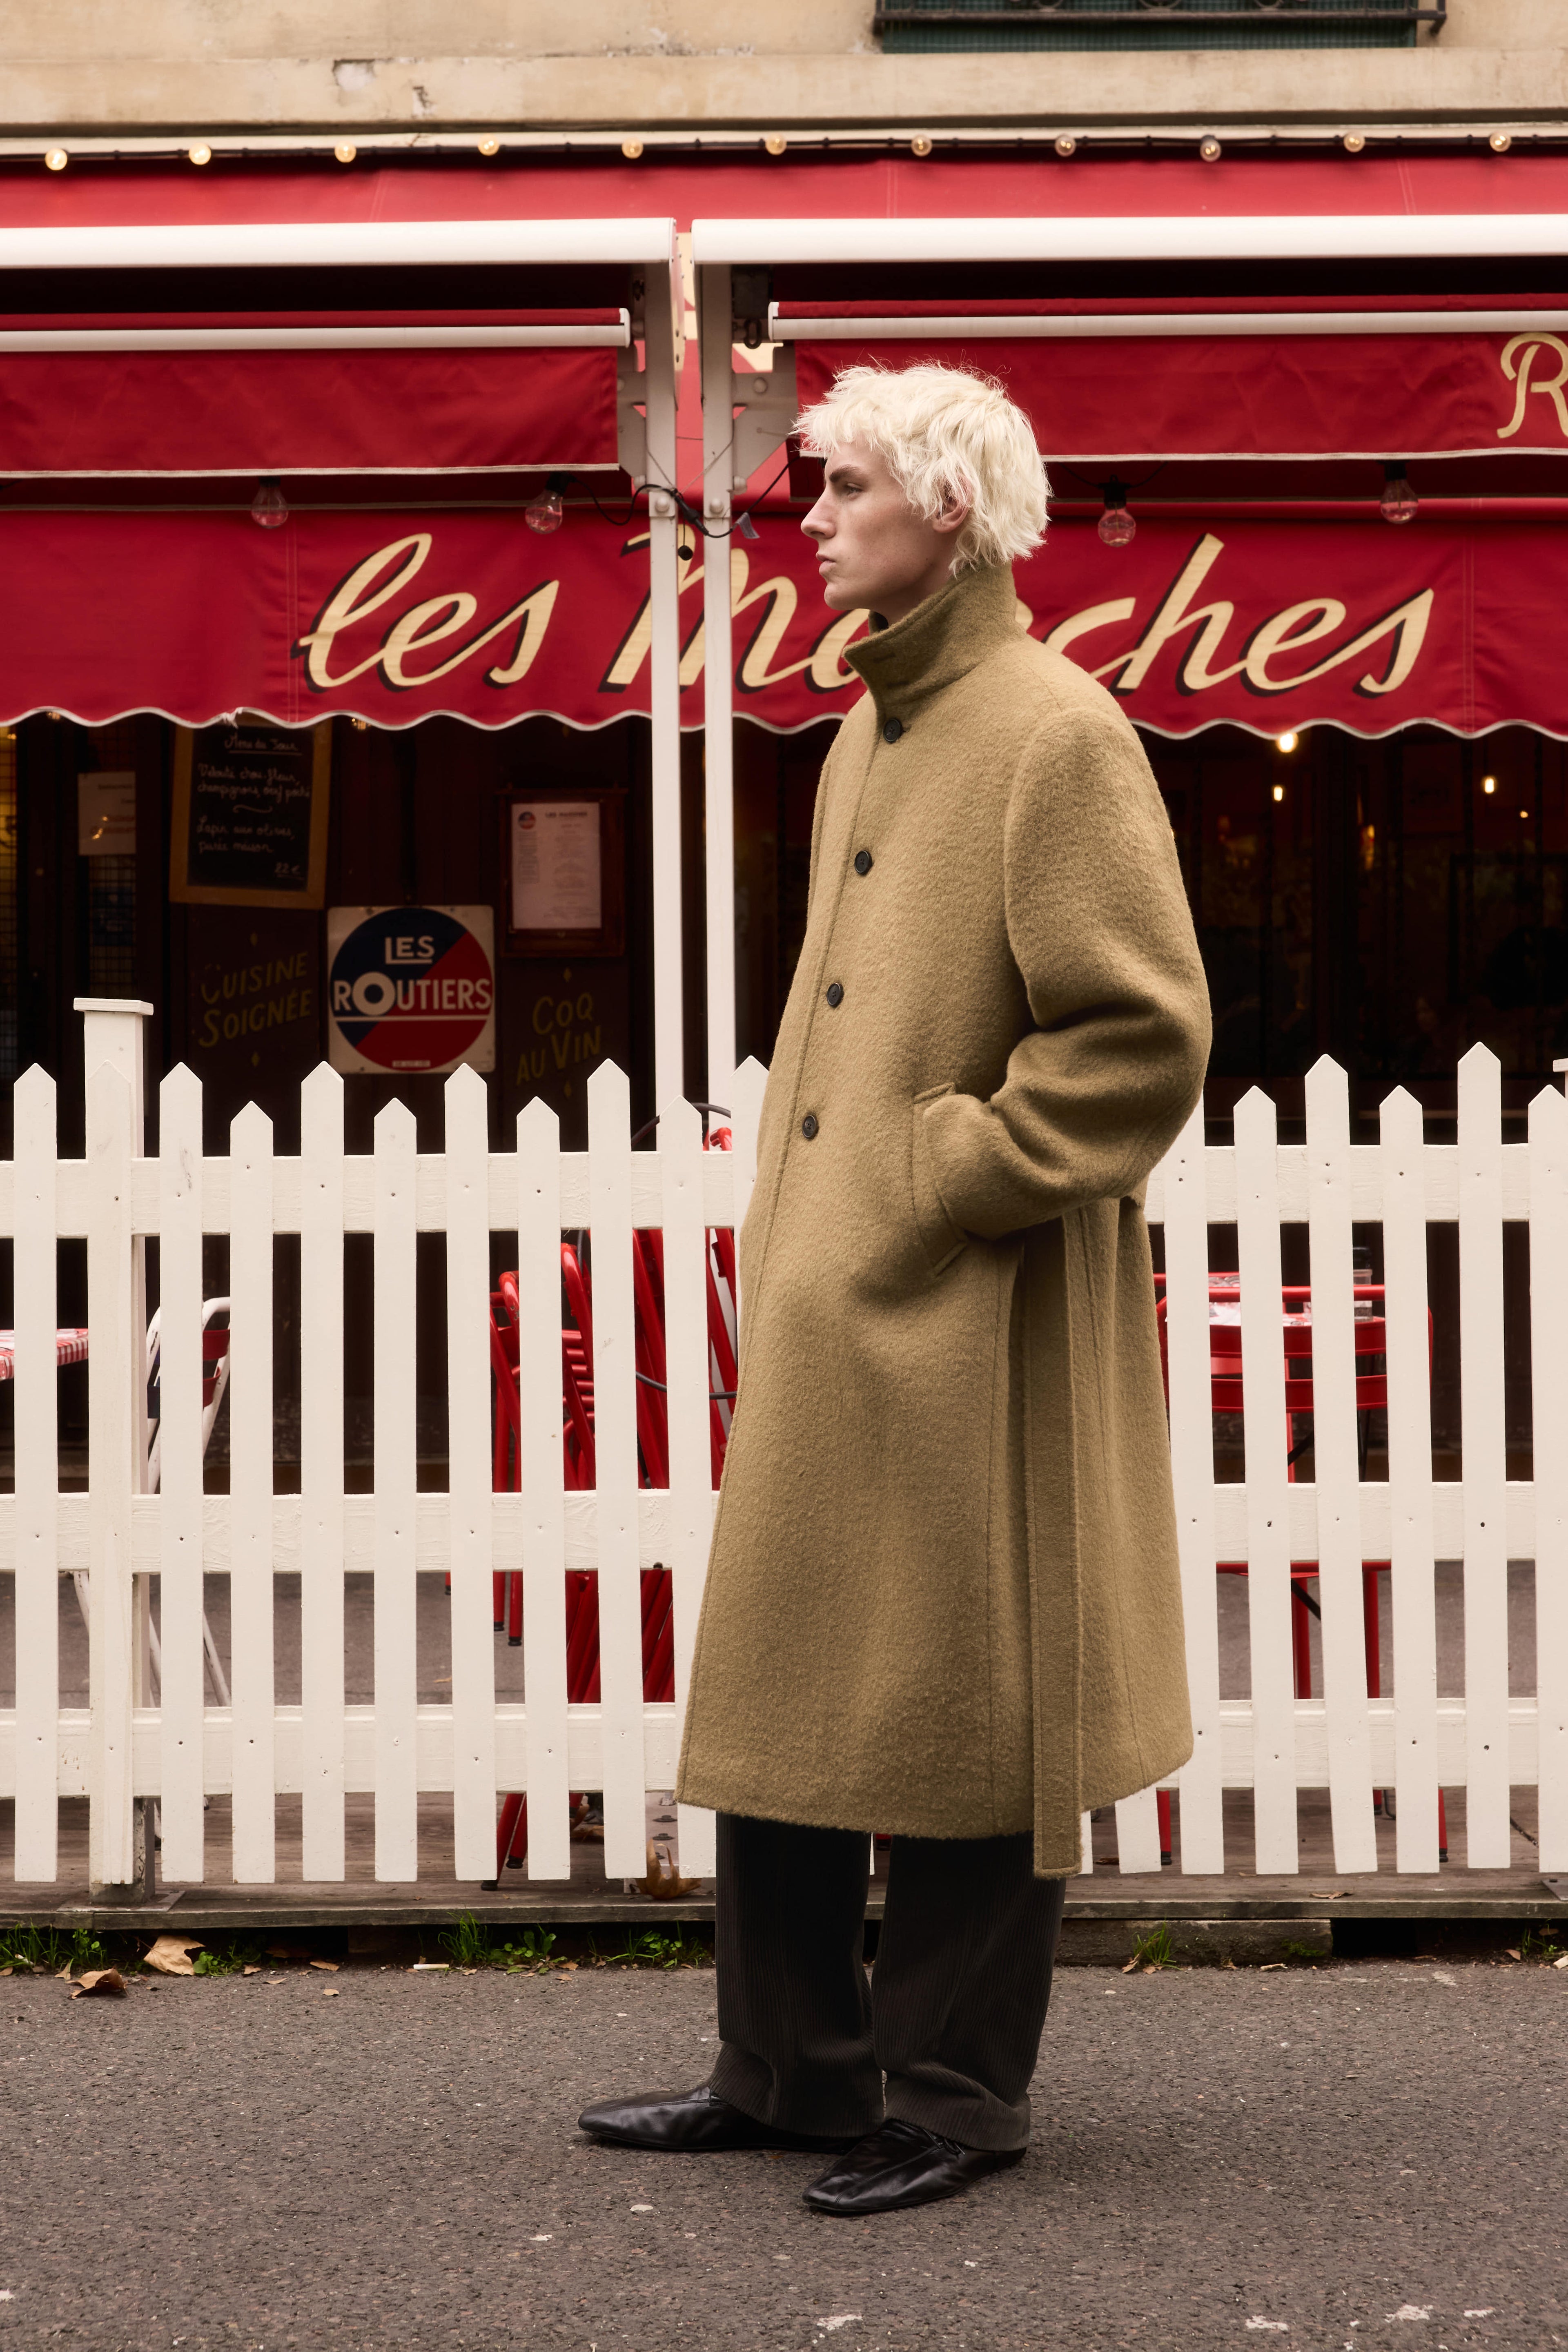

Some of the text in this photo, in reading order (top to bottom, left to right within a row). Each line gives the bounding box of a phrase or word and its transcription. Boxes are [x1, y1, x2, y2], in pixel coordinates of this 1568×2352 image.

[290, 524, 1434, 698] les Maches
[385, 935, 436, 964] LES
[200, 951, 308, 1004] CUISINE
[333, 971, 492, 1016] ROUTIERS
[198, 987, 313, 1048] SOIGNÉE
[532, 991, 594, 1036] COQ
[516, 1024, 601, 1086] AU VIN
